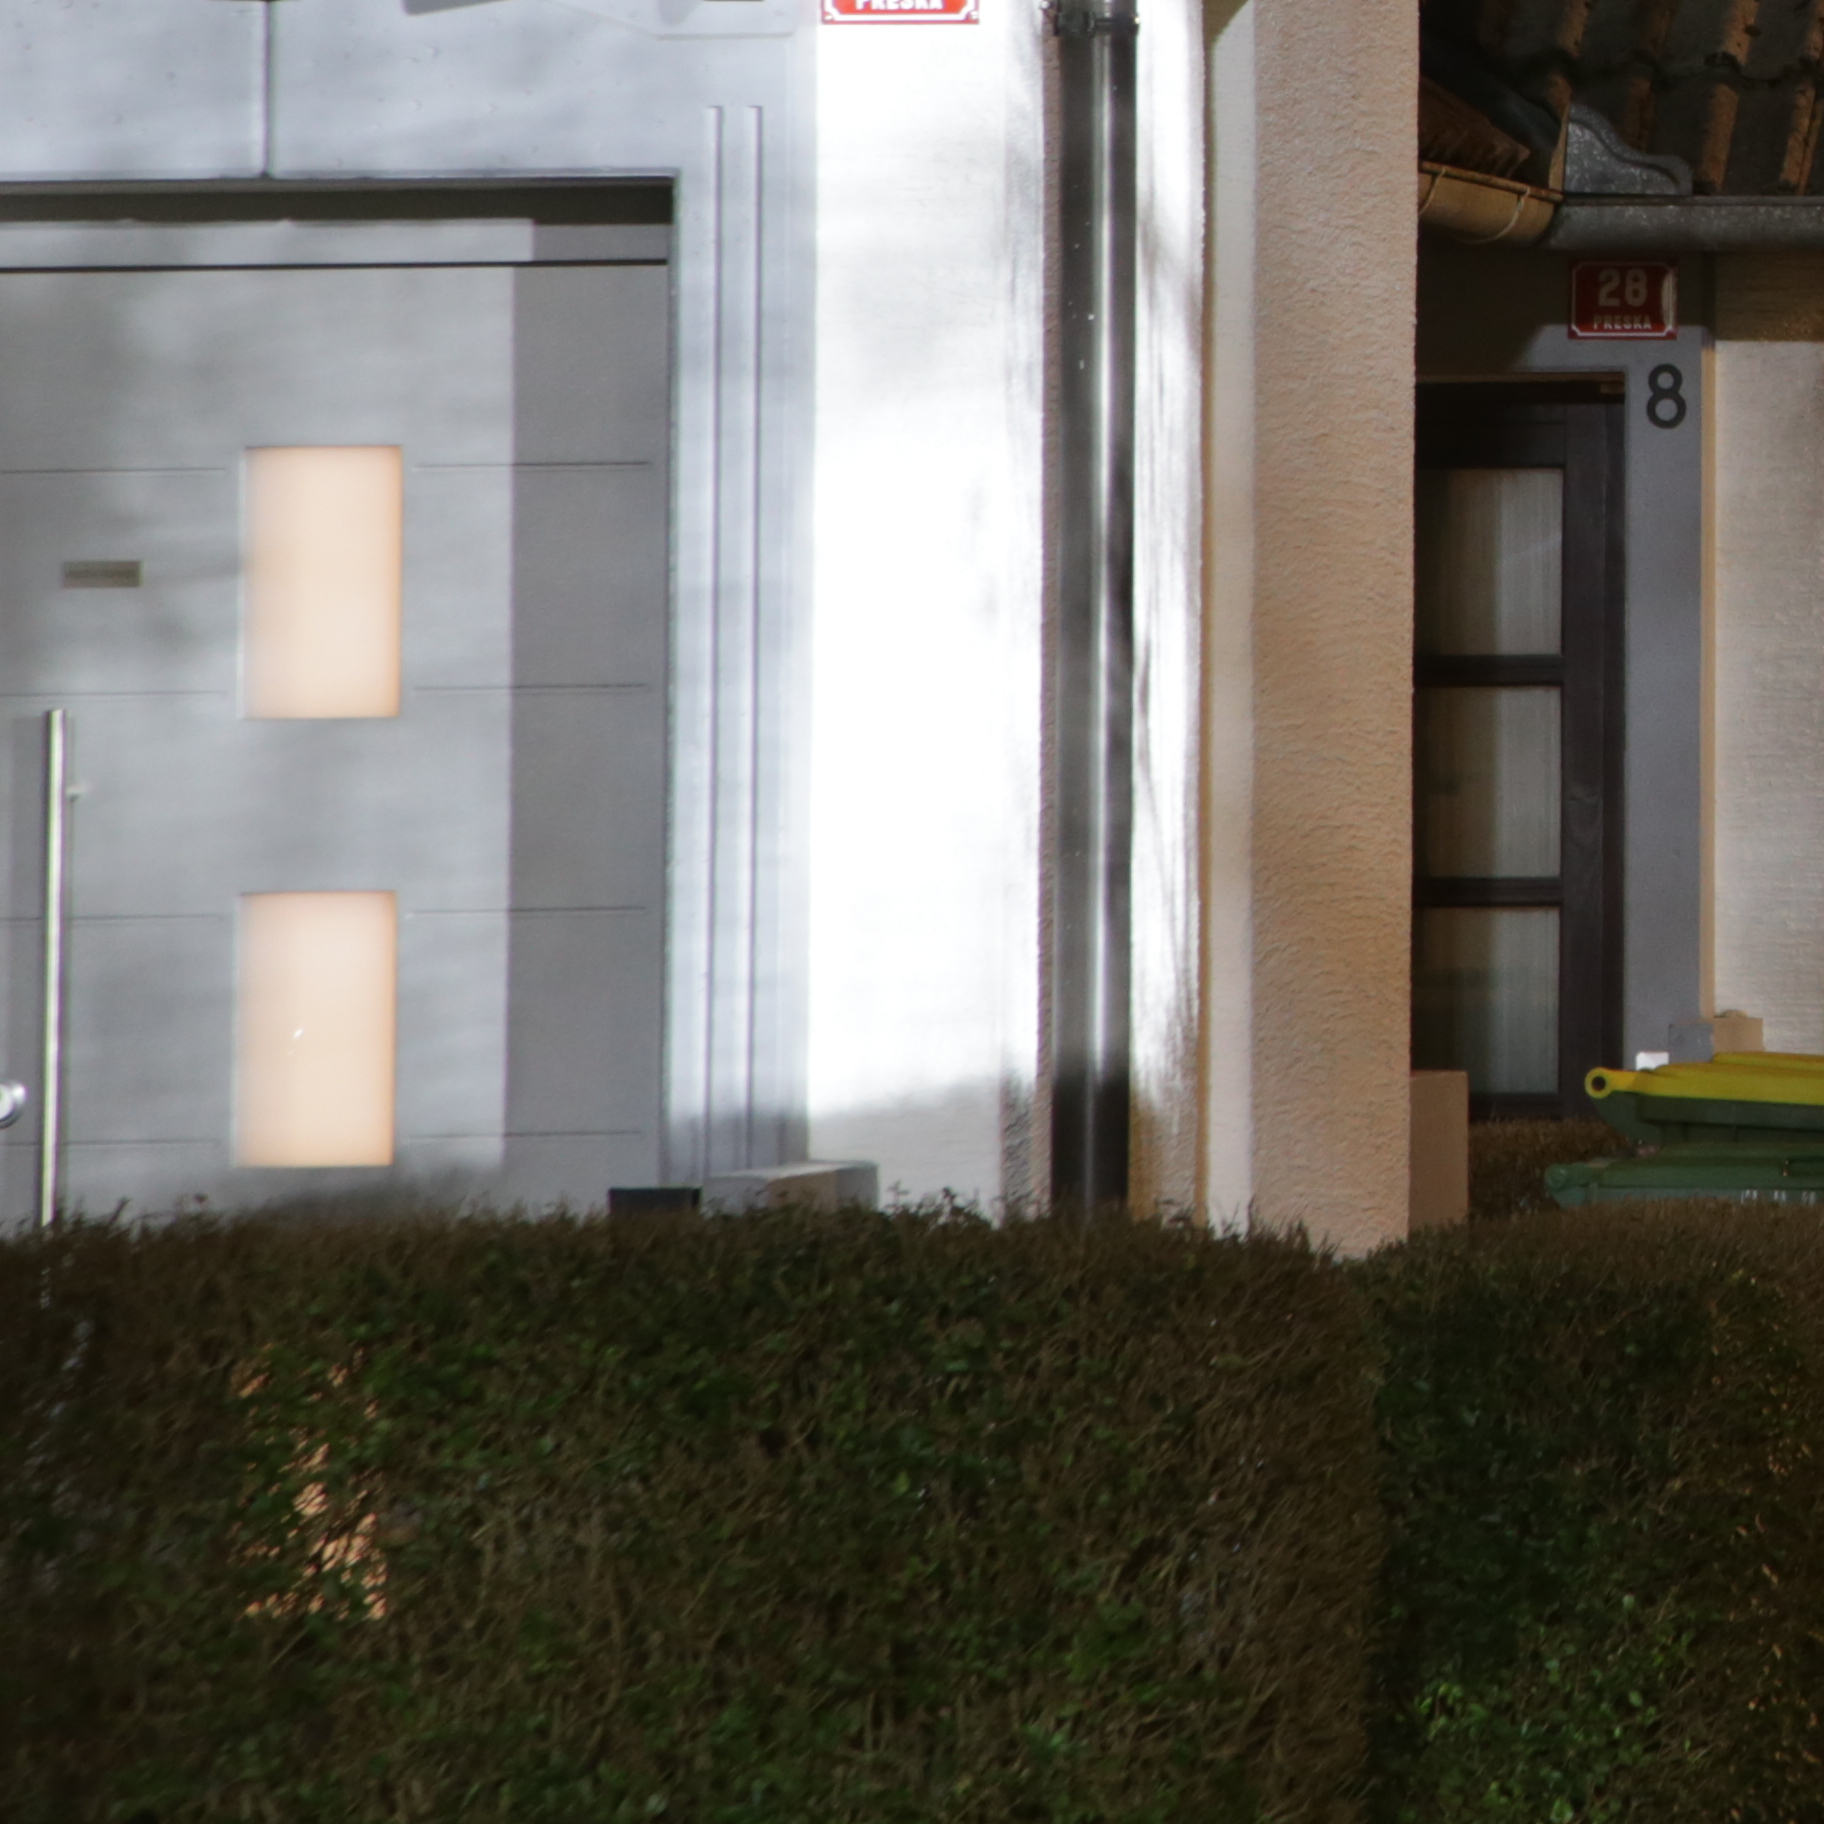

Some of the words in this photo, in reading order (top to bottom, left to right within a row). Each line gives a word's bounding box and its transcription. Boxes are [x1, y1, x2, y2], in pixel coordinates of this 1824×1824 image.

[1598, 268, 1648, 307] 28
[1593, 315, 1652, 331] PRESKA
[1646, 363, 1687, 430] 8
